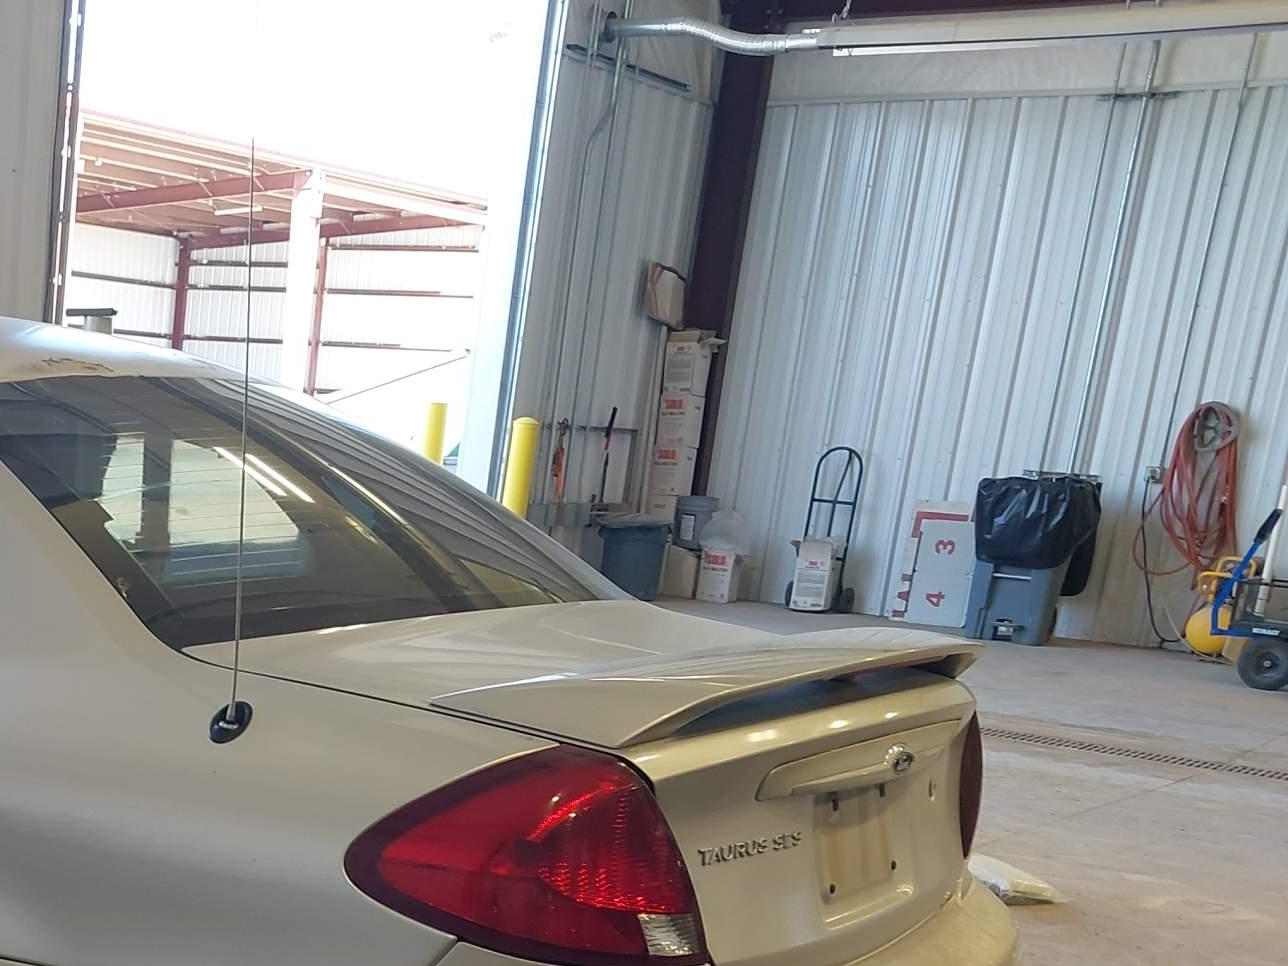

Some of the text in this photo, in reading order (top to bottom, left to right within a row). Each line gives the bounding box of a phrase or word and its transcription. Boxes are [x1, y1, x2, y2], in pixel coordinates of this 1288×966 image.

[926, 539, 956, 607] 4 3
[698, 832, 803, 867] TAURUS SES
